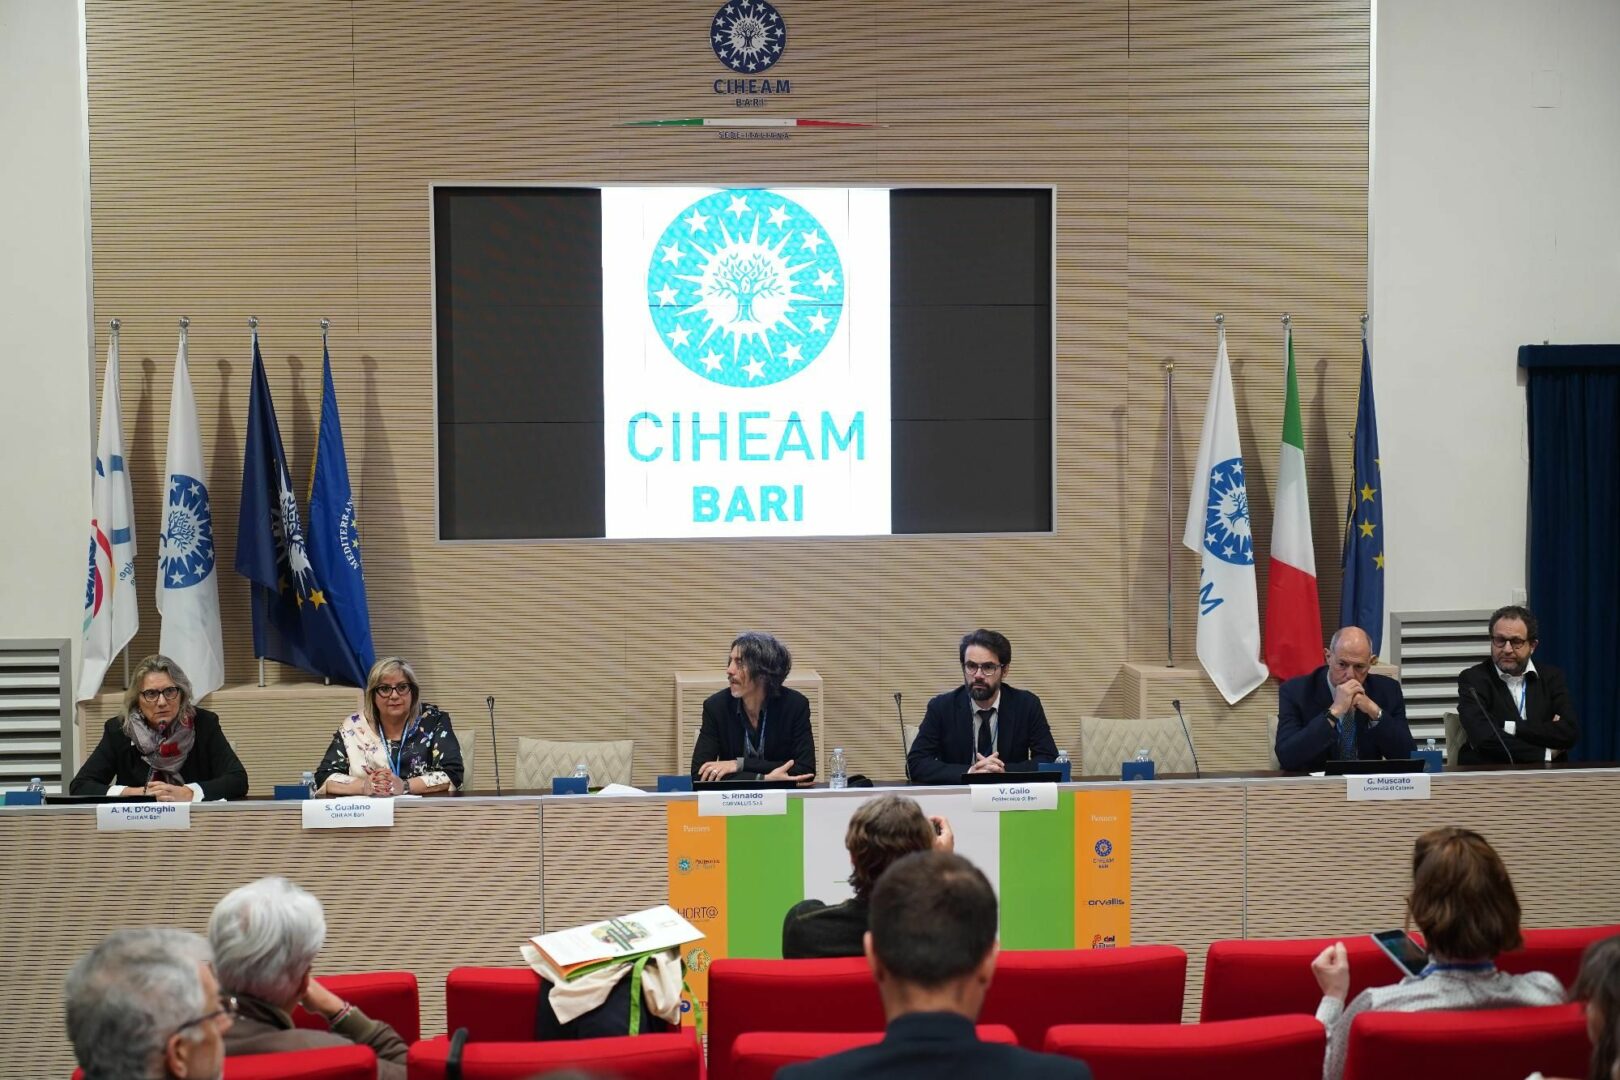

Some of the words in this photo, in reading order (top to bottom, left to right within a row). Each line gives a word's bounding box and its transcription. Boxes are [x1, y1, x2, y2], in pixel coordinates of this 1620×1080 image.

[714, 79, 790, 94] CIHEAM
[735, 98, 764, 107] BARI
[719, 131, 741, 139] SEDE
[627, 411, 865, 462] CIHEAM
[692, 484, 804, 523] BARI
[135, 805, 176, 814] D'Onghia
[335, 803, 371, 811] Gualano
